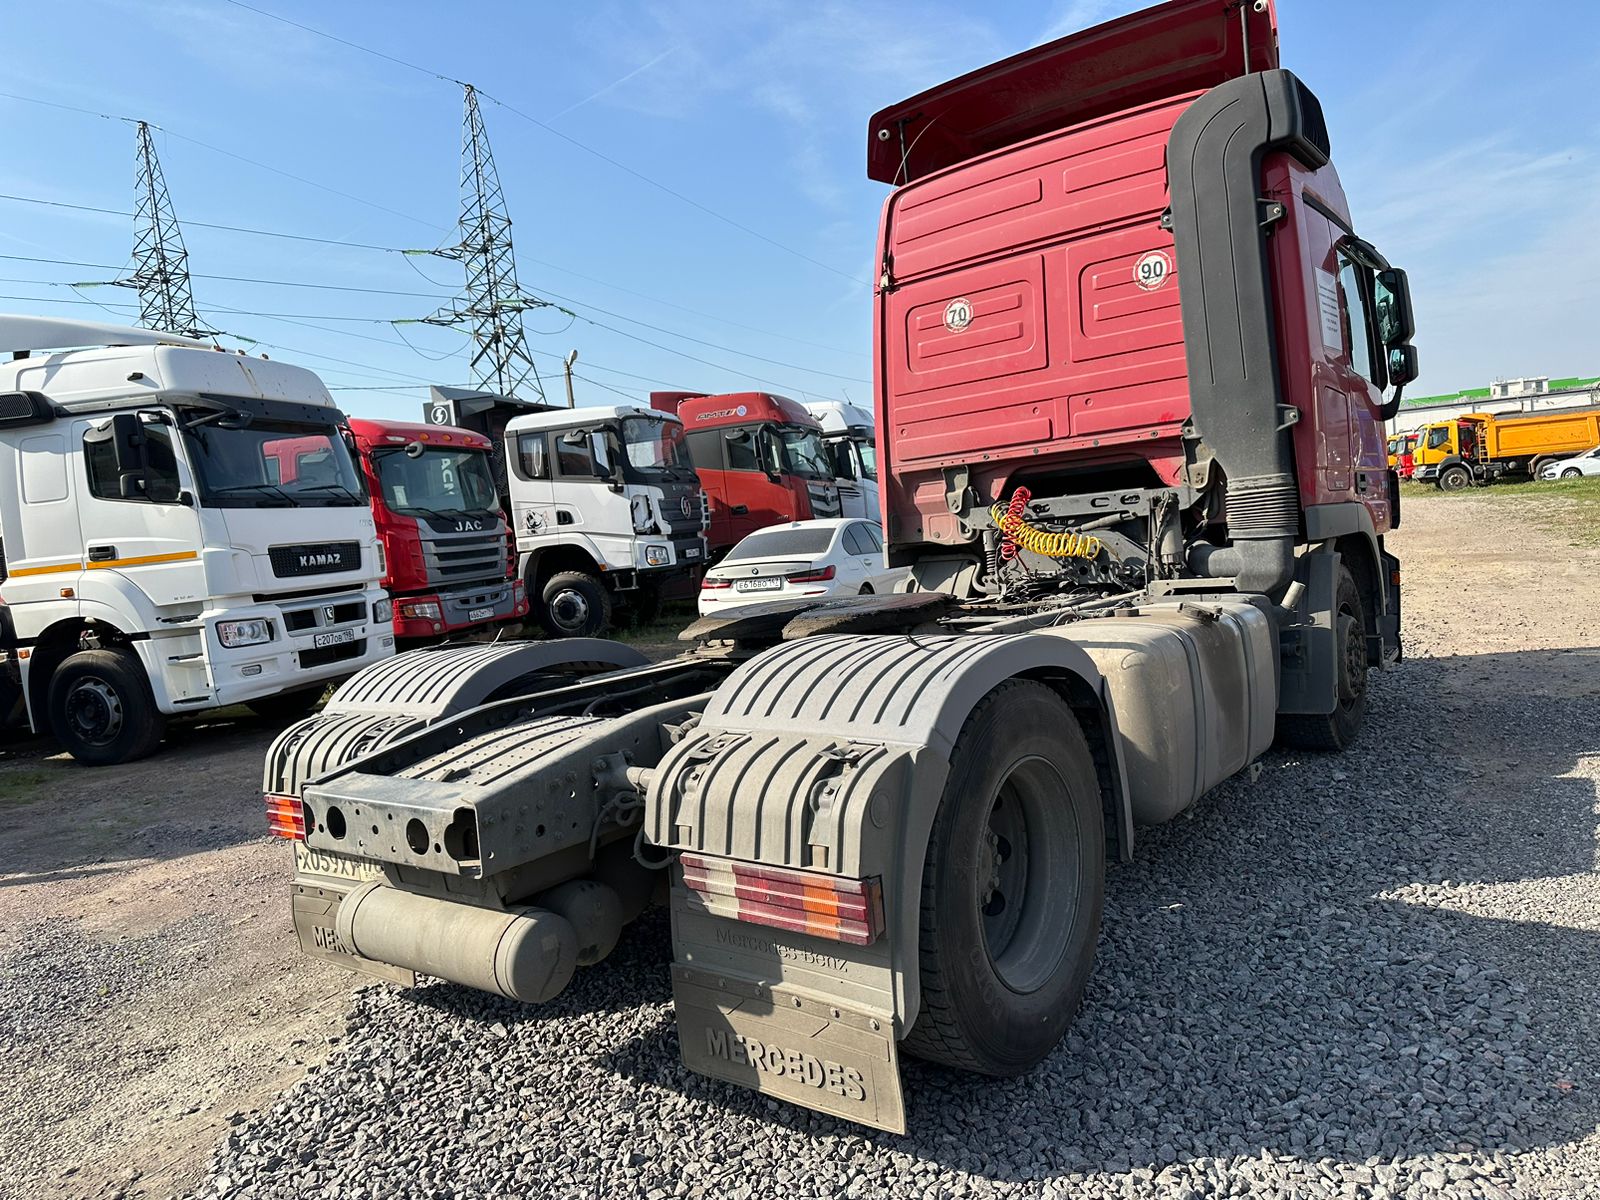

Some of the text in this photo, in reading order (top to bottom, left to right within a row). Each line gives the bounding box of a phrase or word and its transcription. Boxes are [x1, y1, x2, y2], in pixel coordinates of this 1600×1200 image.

[1141, 261, 1164, 280] 90
[949, 307, 967, 324] 70
[455, 520, 482, 532] JAC
[299, 553, 341, 567] KAMAZ
[704, 1026, 867, 1102] MERCEDES
